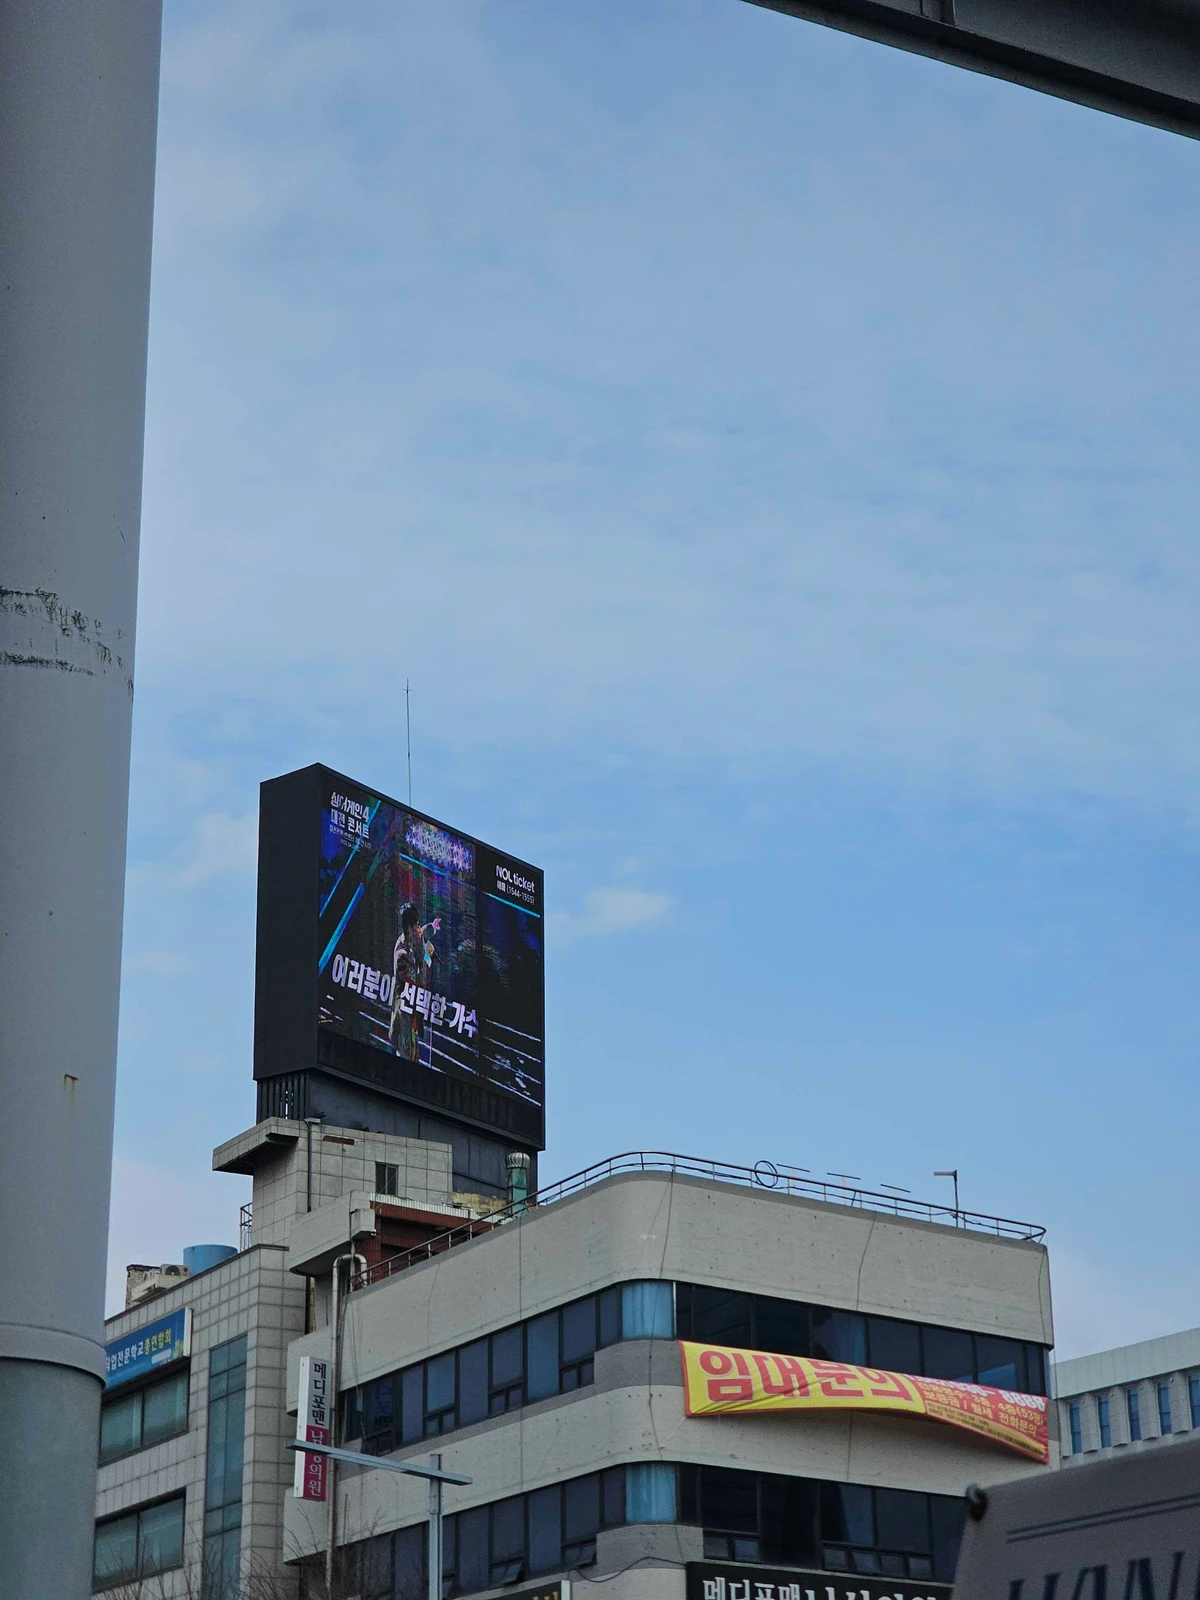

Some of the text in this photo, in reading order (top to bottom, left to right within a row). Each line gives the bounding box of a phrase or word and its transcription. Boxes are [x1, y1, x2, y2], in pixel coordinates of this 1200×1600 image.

[347, 816, 370, 839] 콘서트
[495, 865, 535, 893] NOL ticket
[332, 953, 479, 1039] 여러분이 선택한 가수
[311, 1362, 327, 1427] 메디포맨
[699, 1349, 915, 1402] 임대문의
[998, 1411, 1037, 1438] 전화문의
